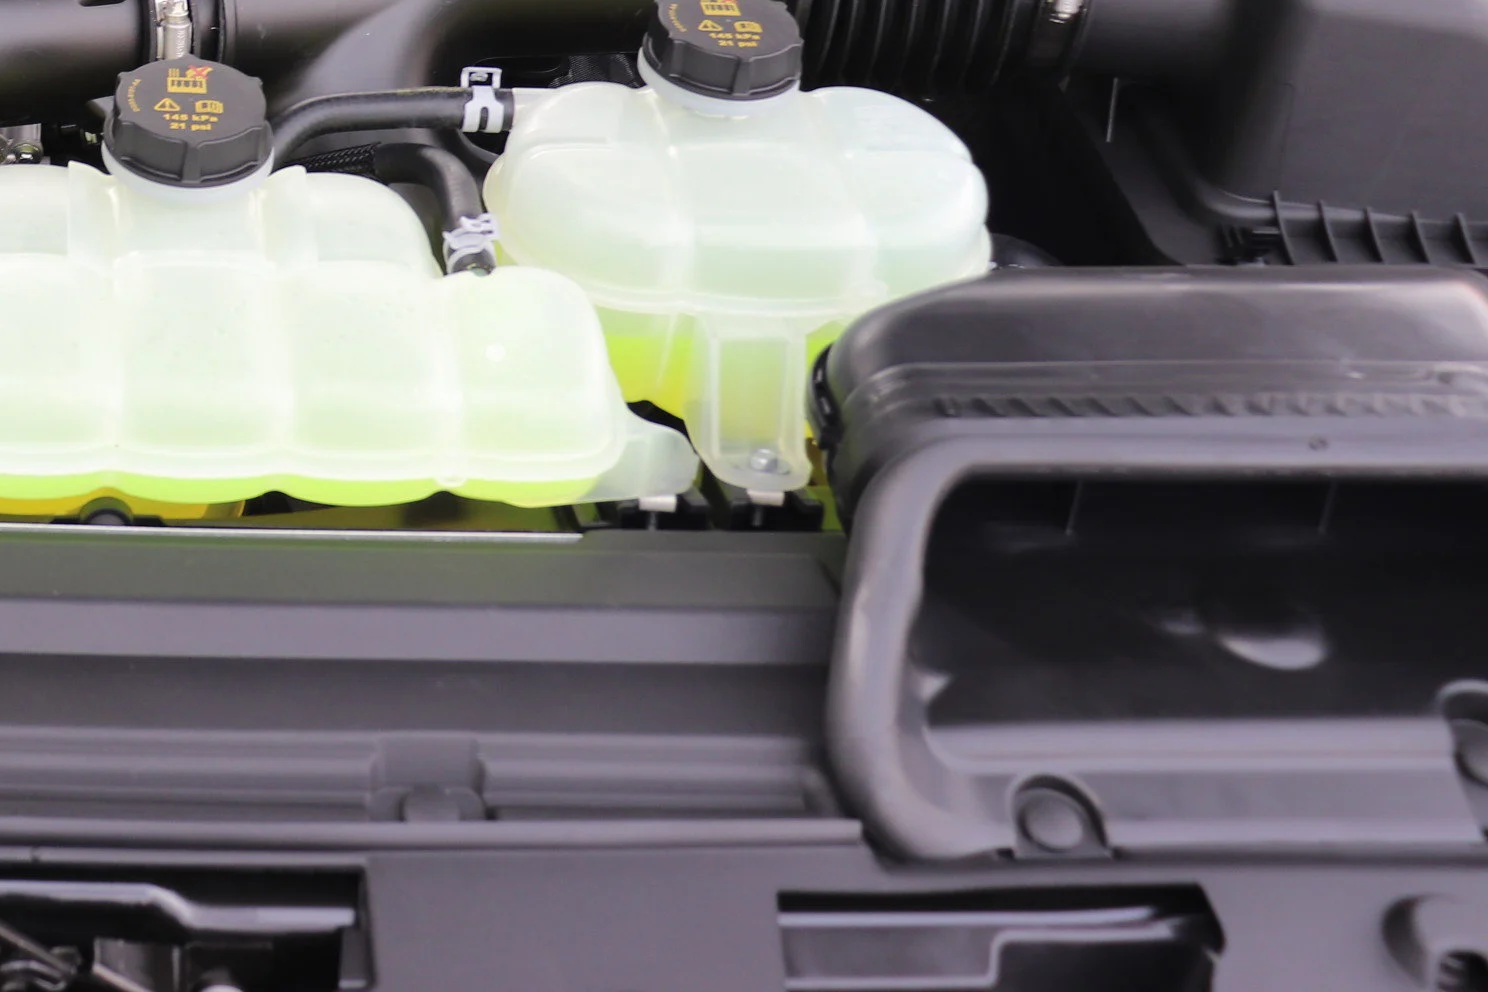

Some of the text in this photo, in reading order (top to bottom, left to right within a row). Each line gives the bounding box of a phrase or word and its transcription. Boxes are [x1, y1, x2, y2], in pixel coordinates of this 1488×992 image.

[735, 33, 761, 41] kPa
[163, 113, 218, 122] 145 kPa
[169, 122, 212, 131] 21 psi
